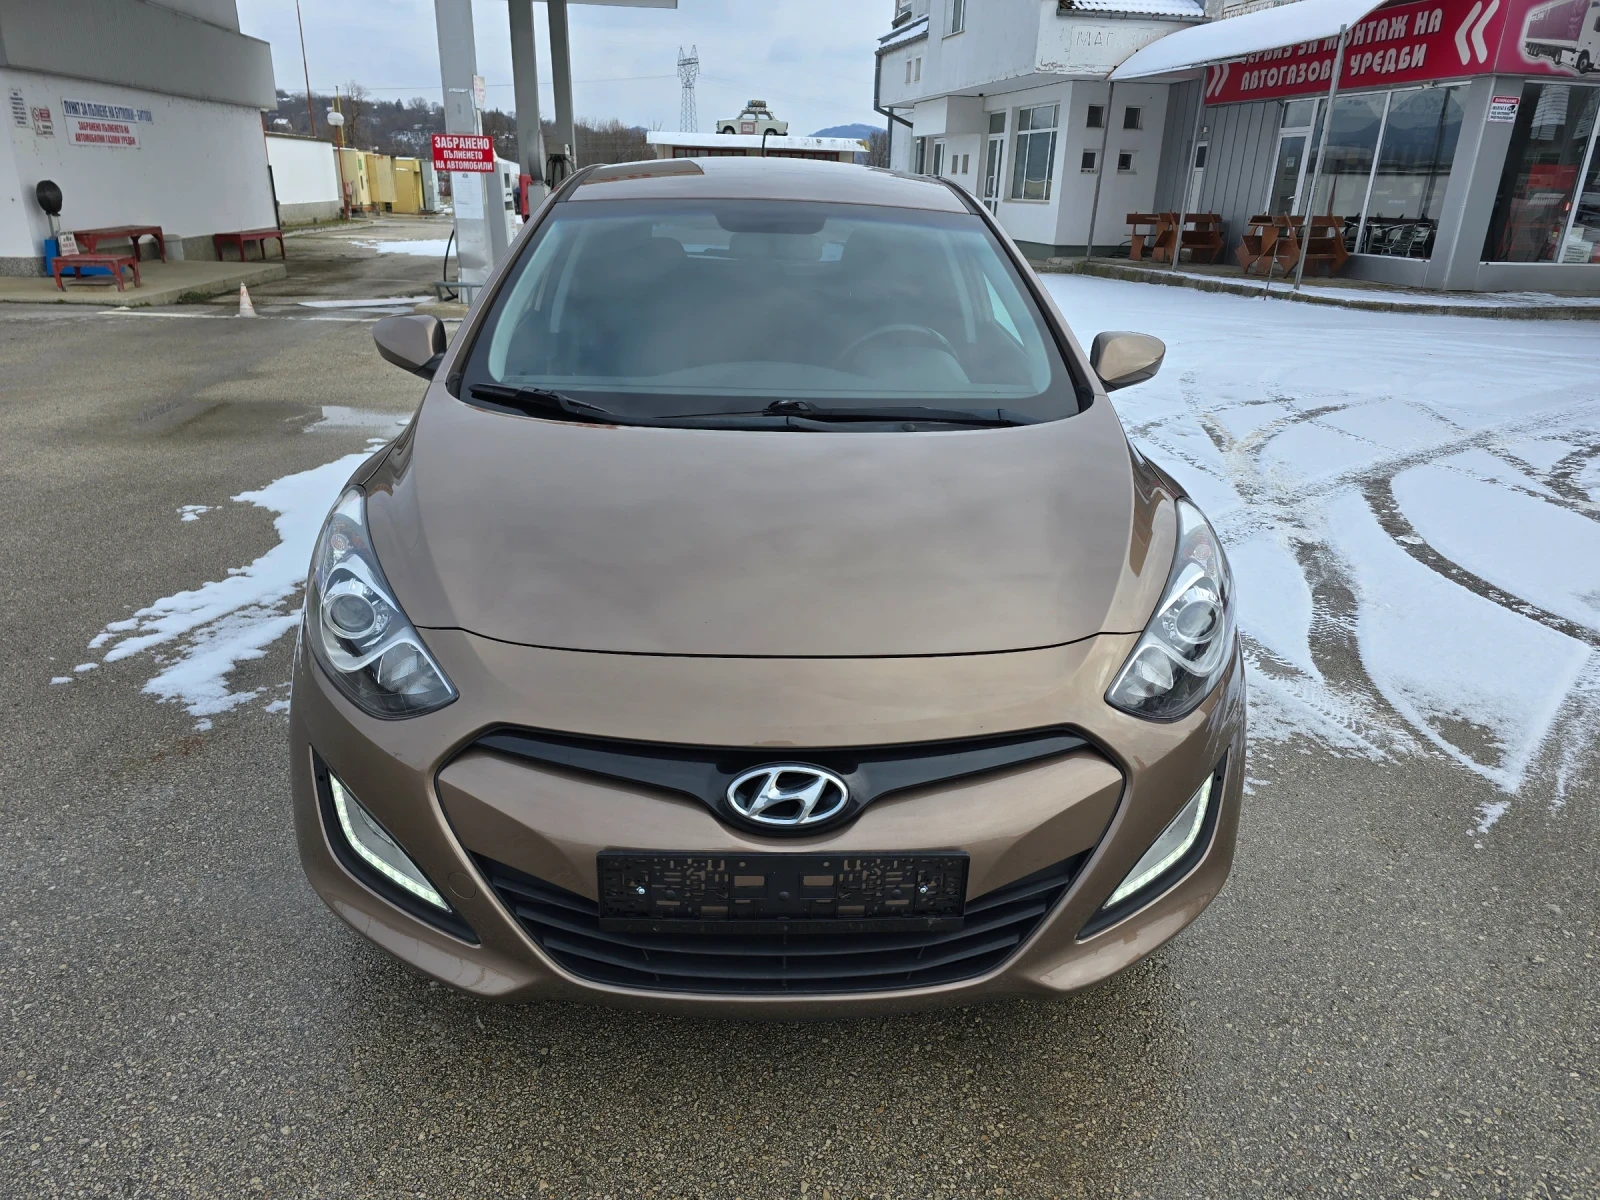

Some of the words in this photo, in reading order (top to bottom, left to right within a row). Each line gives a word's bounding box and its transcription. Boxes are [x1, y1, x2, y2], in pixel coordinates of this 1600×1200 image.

[1413, 8, 1443, 36] НА
[1350, 43, 1428, 76] УРЕДБИ
[434, 136, 490, 150] ЗАБРАНЕНО
[443, 150, 483, 160] ПЪЛНЕНЕТО
[435, 160, 446, 169] НА
[446, 160, 493, 171] АВТОМОБИЛИ
